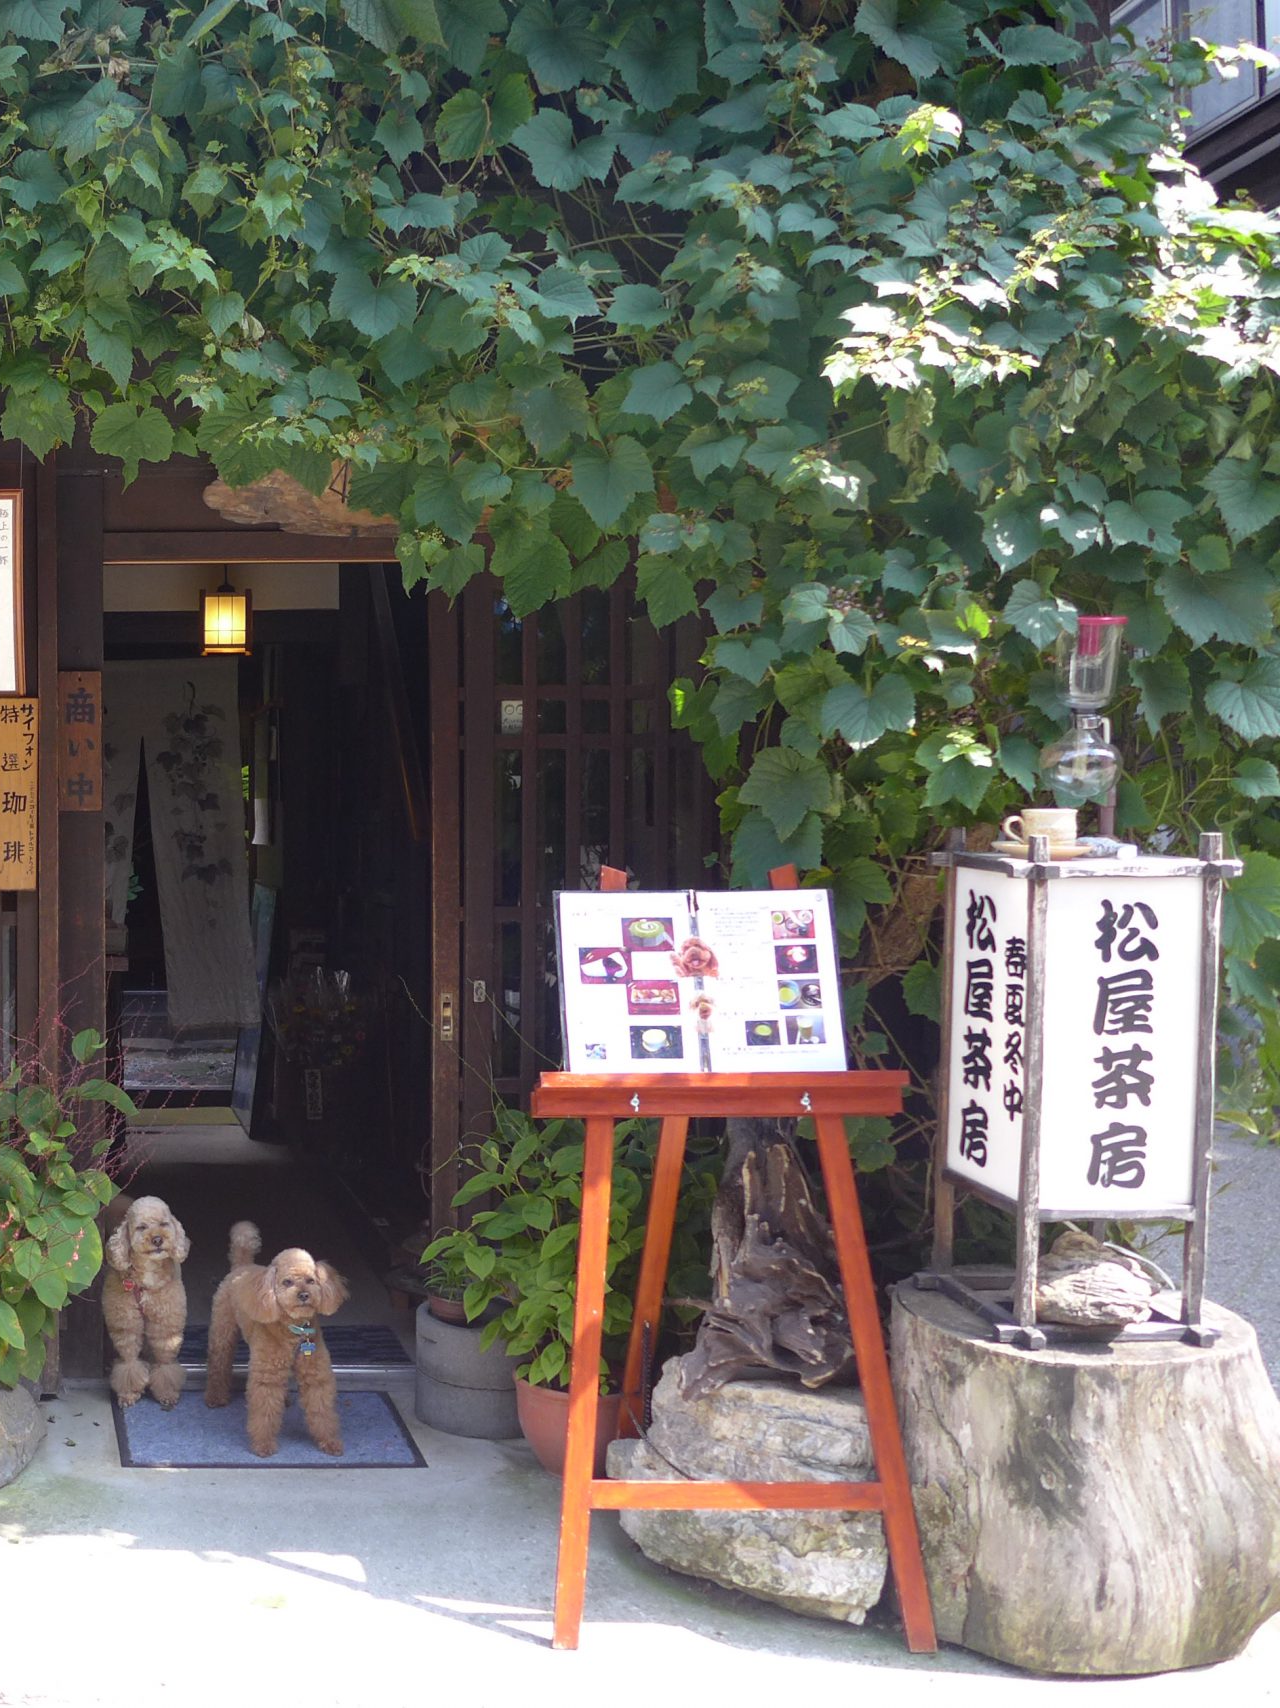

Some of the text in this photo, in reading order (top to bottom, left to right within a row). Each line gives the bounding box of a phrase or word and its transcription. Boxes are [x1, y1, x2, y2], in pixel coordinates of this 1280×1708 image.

[0, 704, 27, 865] 特選珈琲
[20, 703, 35, 772] サイフォン
[64, 686, 97, 807] 商い中
[959, 888, 998, 1169] 松屋茶房
[1003, 935, 1027, 1122] 春夏冬中
[1086, 898, 1161, 1190] 松屋茶房
